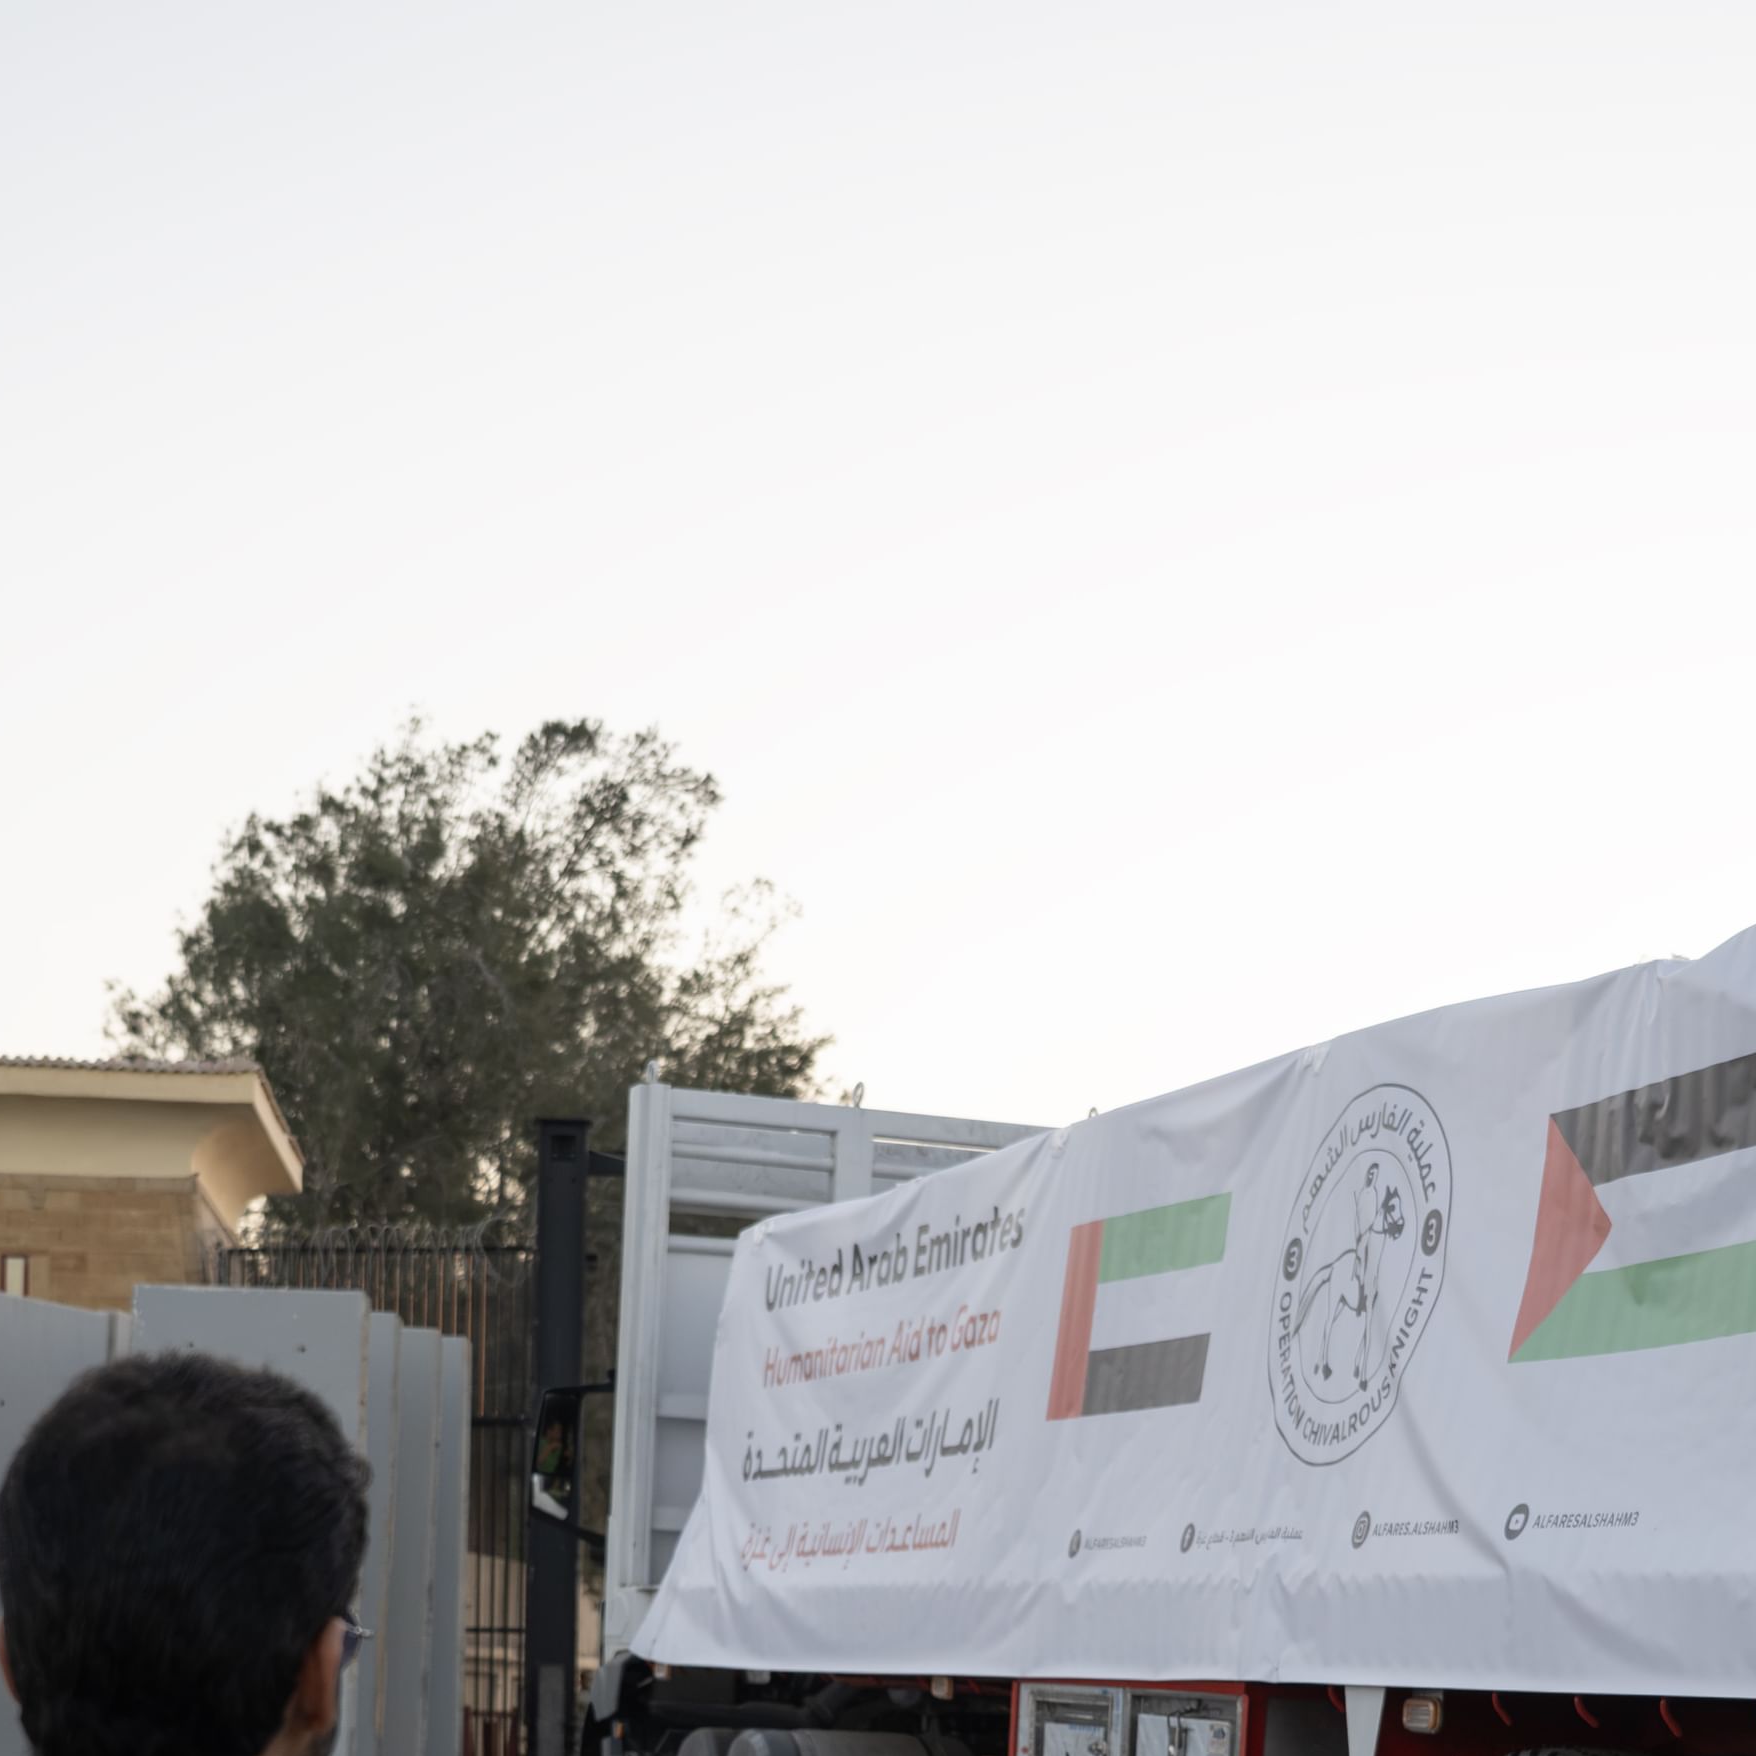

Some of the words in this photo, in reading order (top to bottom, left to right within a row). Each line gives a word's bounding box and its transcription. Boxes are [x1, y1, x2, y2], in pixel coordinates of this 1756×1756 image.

[765, 1249, 843, 1312] United
[846, 1233, 908, 1294] Arab
[913, 1206, 1025, 1278] Emirates
[763, 1331, 885, 1388] Humanitarian
[888, 1316, 925, 1366] Aid
[927, 1318, 947, 1358] to
[951, 1304, 1002, 1352] Gaza
[1279, 1292, 1305, 1430] OPERATION
[1303, 1376, 1391, 1446] CHIVALROUS
[1389, 1267, 1433, 1378] KNIGHT
[743, 1428, 828, 1482] المتحدة
[828, 1416, 906, 1486] العربية
[906, 1398, 999, 1478] الإمارات
[1533, 1511, 1639, 1529] ALFARESALSHAHM3
